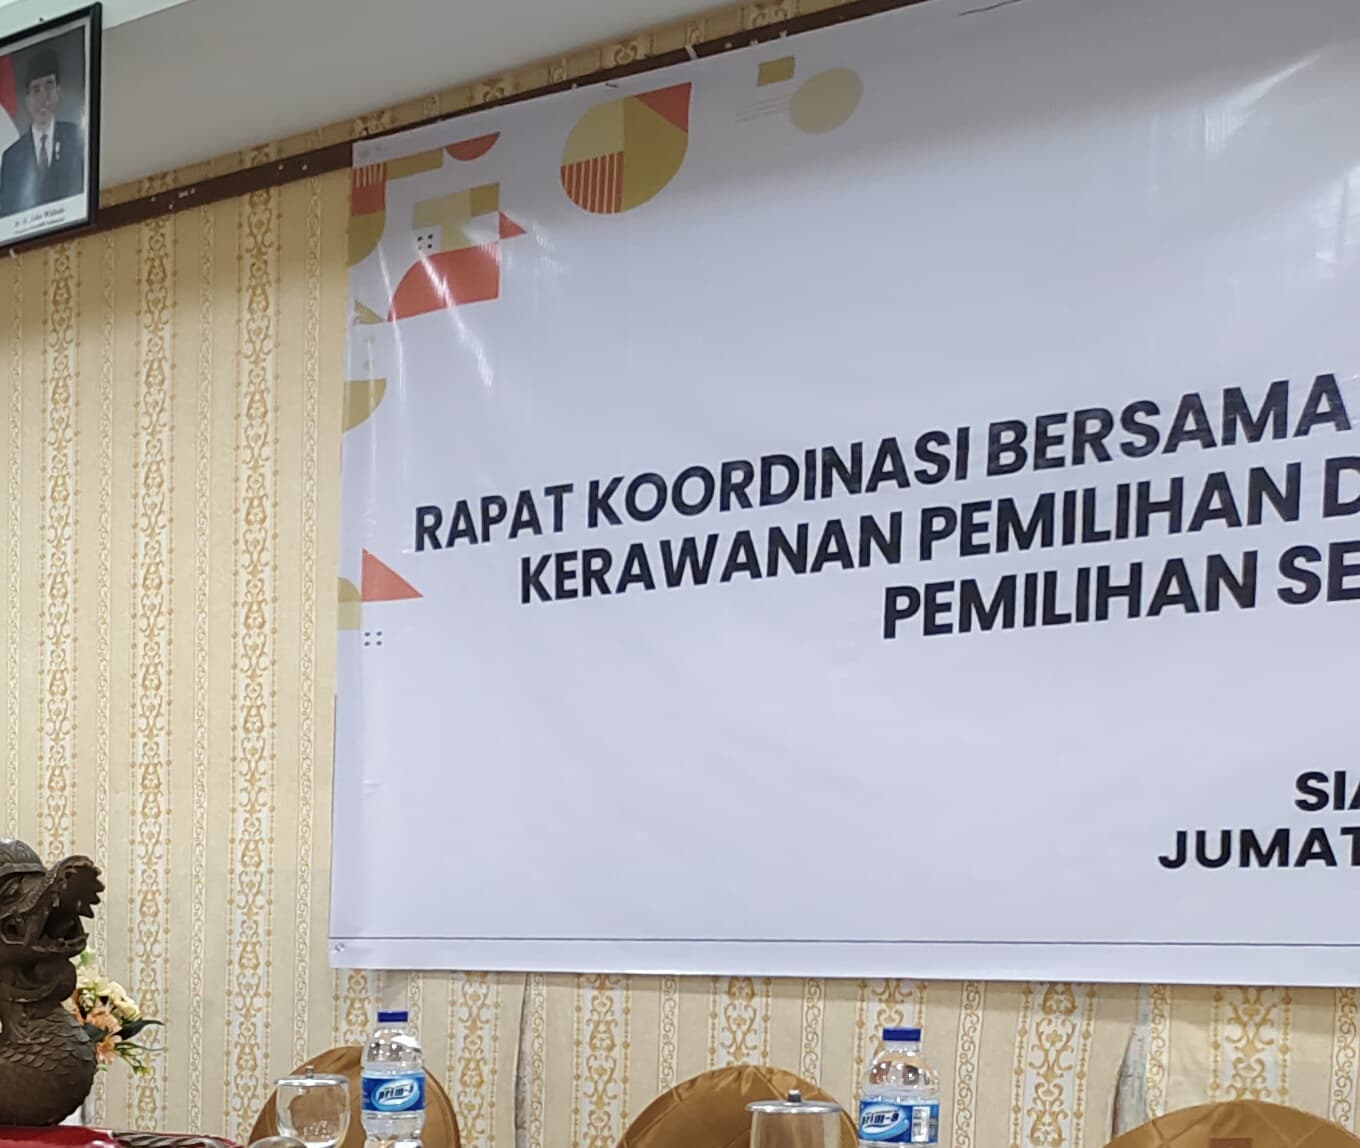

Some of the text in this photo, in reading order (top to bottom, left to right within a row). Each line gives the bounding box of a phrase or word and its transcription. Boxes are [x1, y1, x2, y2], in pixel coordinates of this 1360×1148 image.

[414, 372, 1353, 553] RAPAT KOORDINASI BERSAMA
[520, 510, 904, 605] KERAWANAN
[918, 461, 1302, 562] PEMILIHAN
[882, 539, 1360, 640] PEMILIHAN SE
